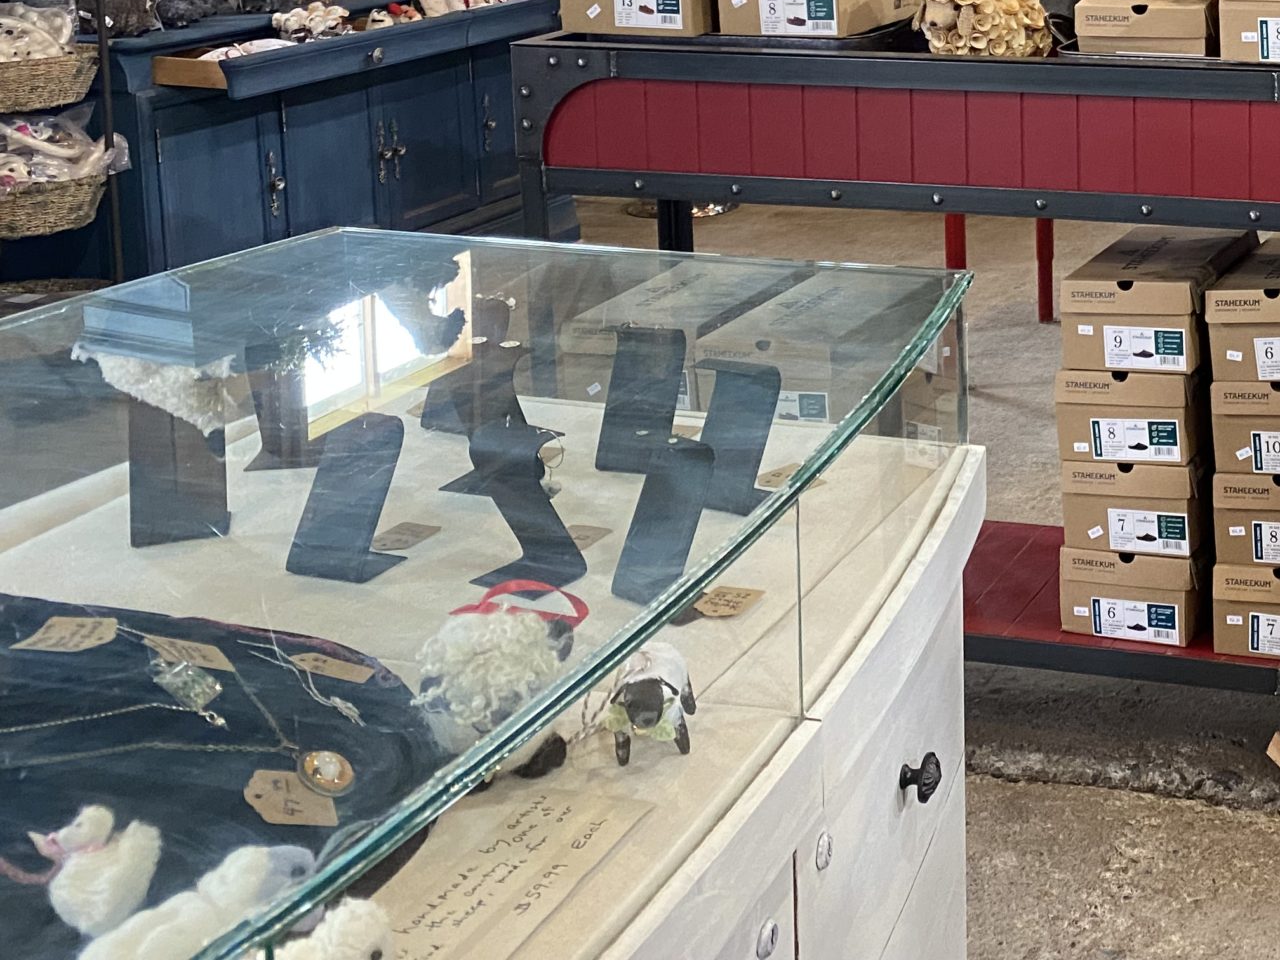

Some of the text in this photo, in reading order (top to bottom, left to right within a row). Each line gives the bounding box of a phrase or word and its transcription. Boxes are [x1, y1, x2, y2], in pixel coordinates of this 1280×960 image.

[768, 3, 776, 15] 8
[1071, 291, 1115, 299] STAHEEKUM
[1215, 299, 1260, 307] STAHEEKUM
[1114, 335, 1122, 348] 9
[1265, 347, 1274, 359] 6
[1065, 381, 1110, 390] STAHEEKUM
[1223, 392, 1269, 400] STAHEEKUM
[1108, 427, 1115, 440] 8
[1072, 471, 1116, 480] STAHEEKUM
[1223, 486, 1270, 495] STAHEEKUM
[1118, 519, 1125, 532] 7
[1269, 530, 1278, 543] 8
[1072, 558, 1115, 569] STAHEEKUM
[1225, 578, 1271, 588] STAHEEKUM
[1108, 607, 1115, 619] 6
[1267, 623, 1275, 636] 7
[479, 839, 512, 855] by
[514, 819, 608, 916] $59.99 Each
